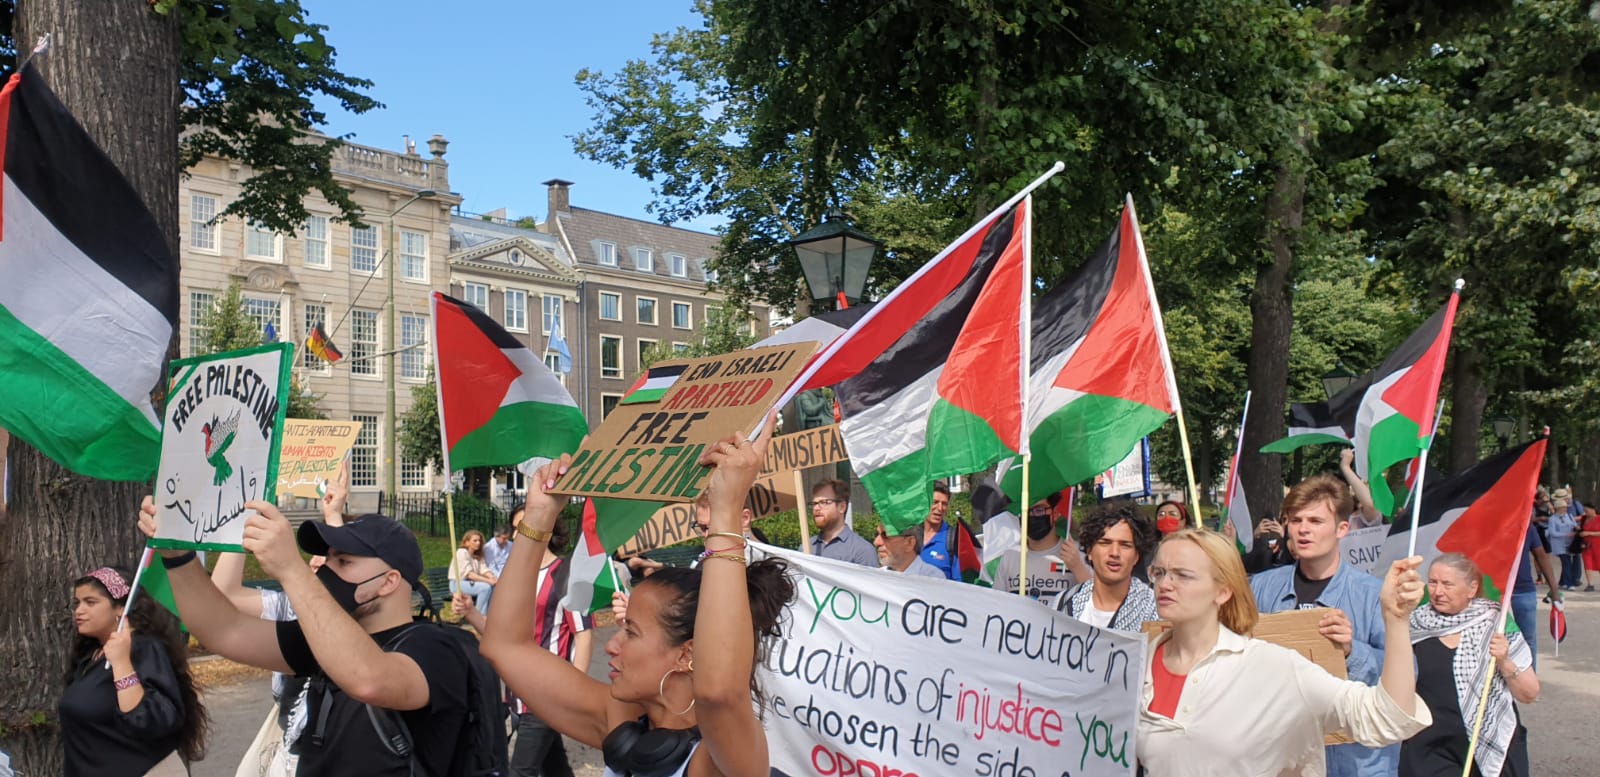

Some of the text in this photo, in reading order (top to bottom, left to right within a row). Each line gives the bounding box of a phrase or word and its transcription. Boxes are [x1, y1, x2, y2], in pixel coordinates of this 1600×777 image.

[686, 350, 796, 382] END ISRAELI
[172, 364, 280, 440] FREE PALESTINE
[660, 377, 774, 411] APARTHEID
[305, 445, 337, 458] RIGHTS
[615, 411, 710, 446] FREE
[554, 443, 713, 498] PALESTINE
[806, 577, 1128, 691] you are neutral in
[793, 694, 899, 758] chosen
[909, 722, 960, 766] the
[916, 668, 955, 721] of
[956, 682, 1064, 747] injustice
[1075, 711, 1130, 771] you
